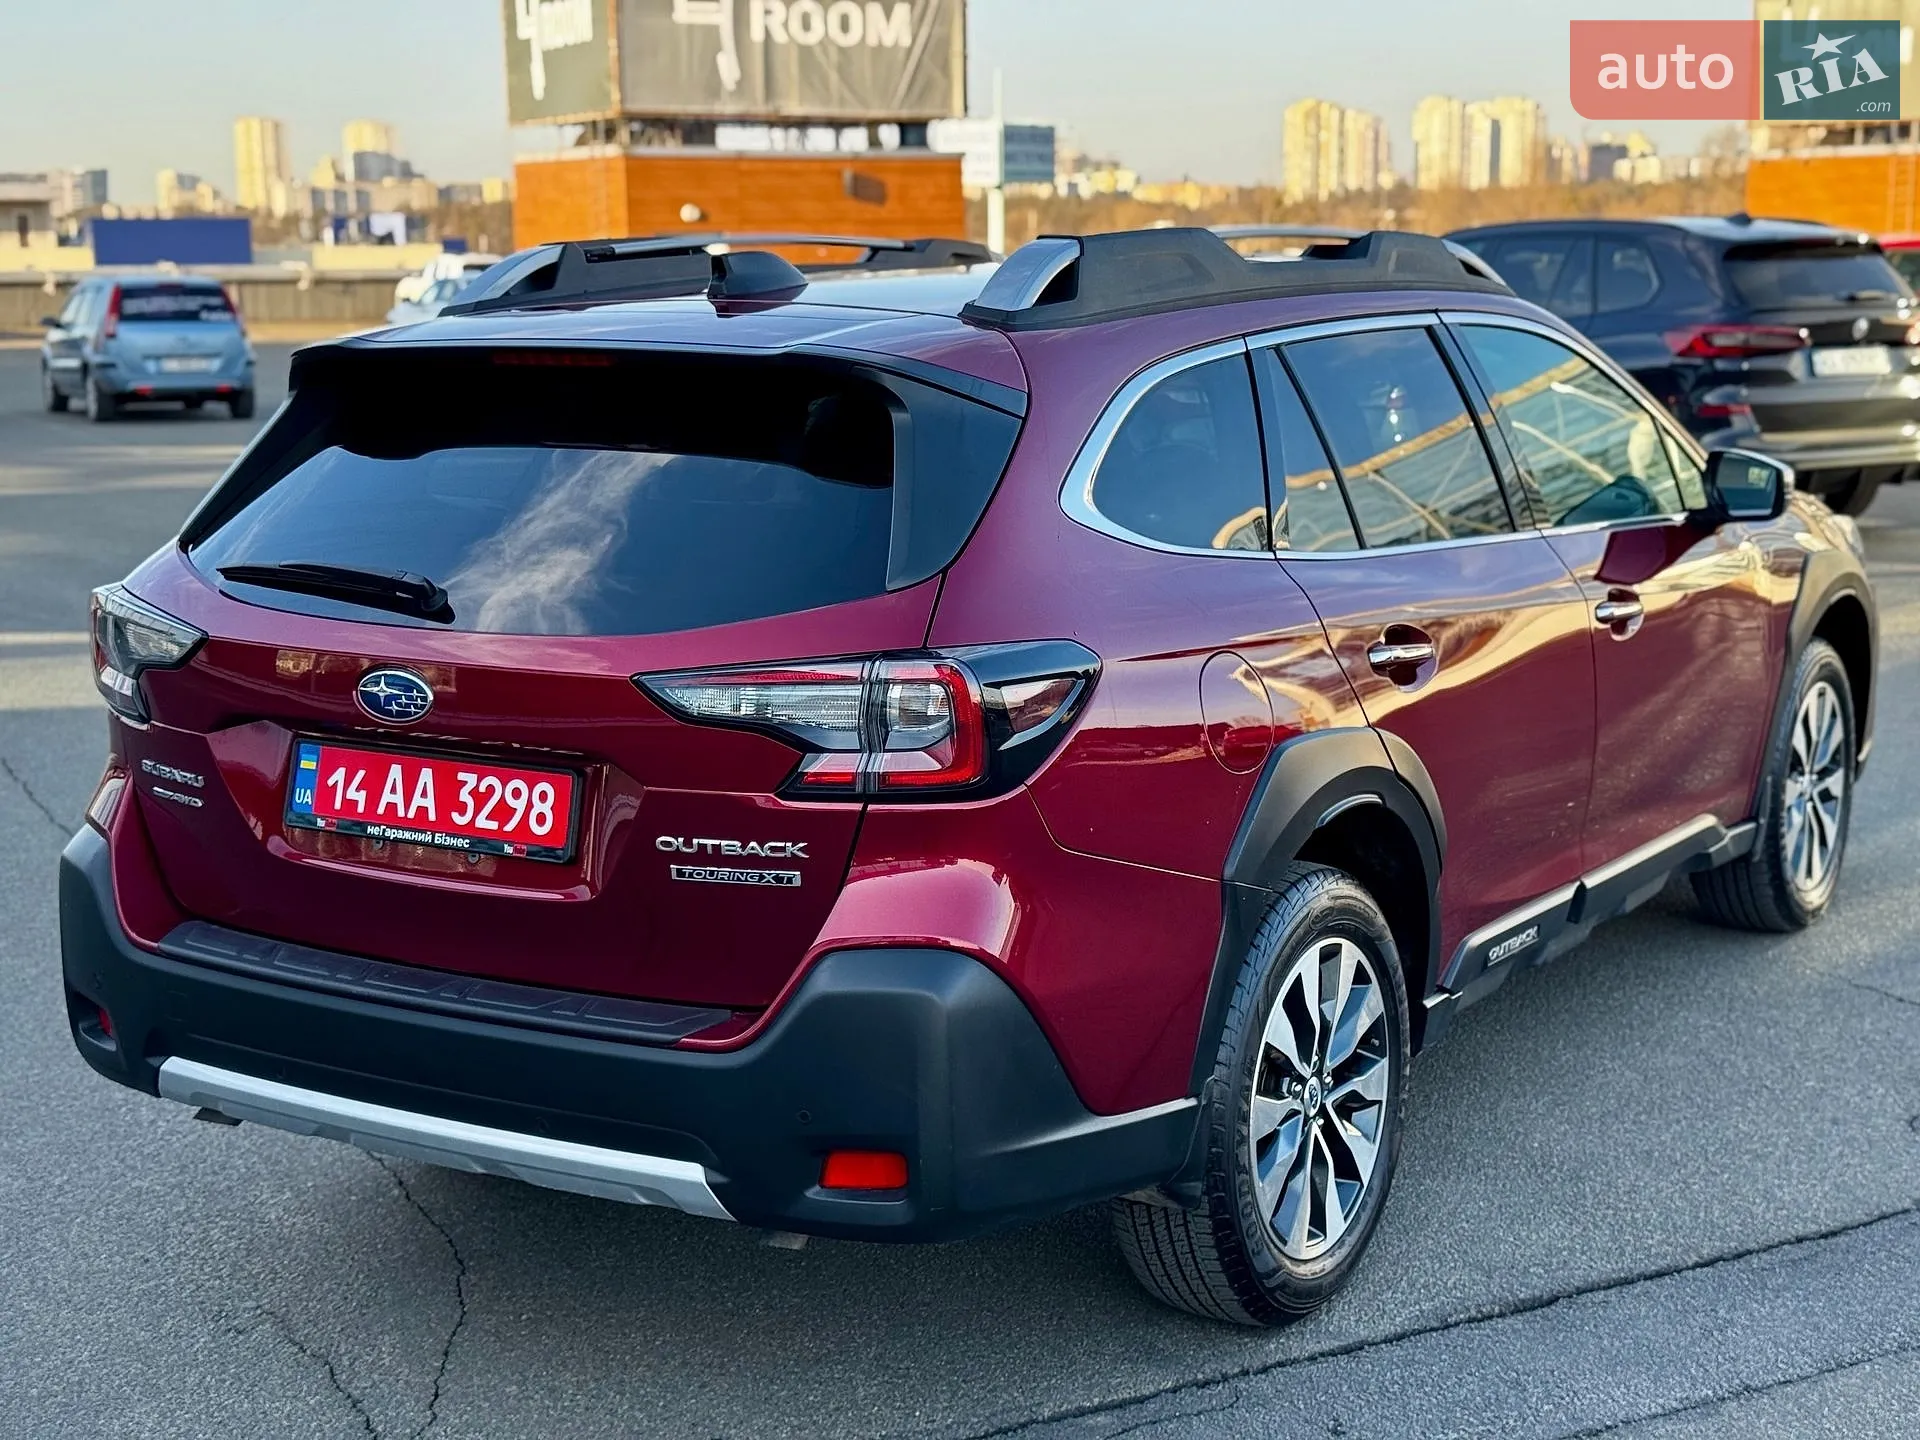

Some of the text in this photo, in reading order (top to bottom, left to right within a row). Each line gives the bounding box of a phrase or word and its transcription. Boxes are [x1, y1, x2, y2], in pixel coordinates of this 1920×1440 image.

[750, 0, 913, 48] ROOM
[141, 759, 205, 787] SUBARU
[295, 788, 312, 806] UA
[326, 763, 556, 836] 14 AA 3298
[366, 825, 471, 848] неГаражний Бізнес
[655, 835, 810, 858] OUTBACK
[1488, 925, 1539, 961] OUTBACK
